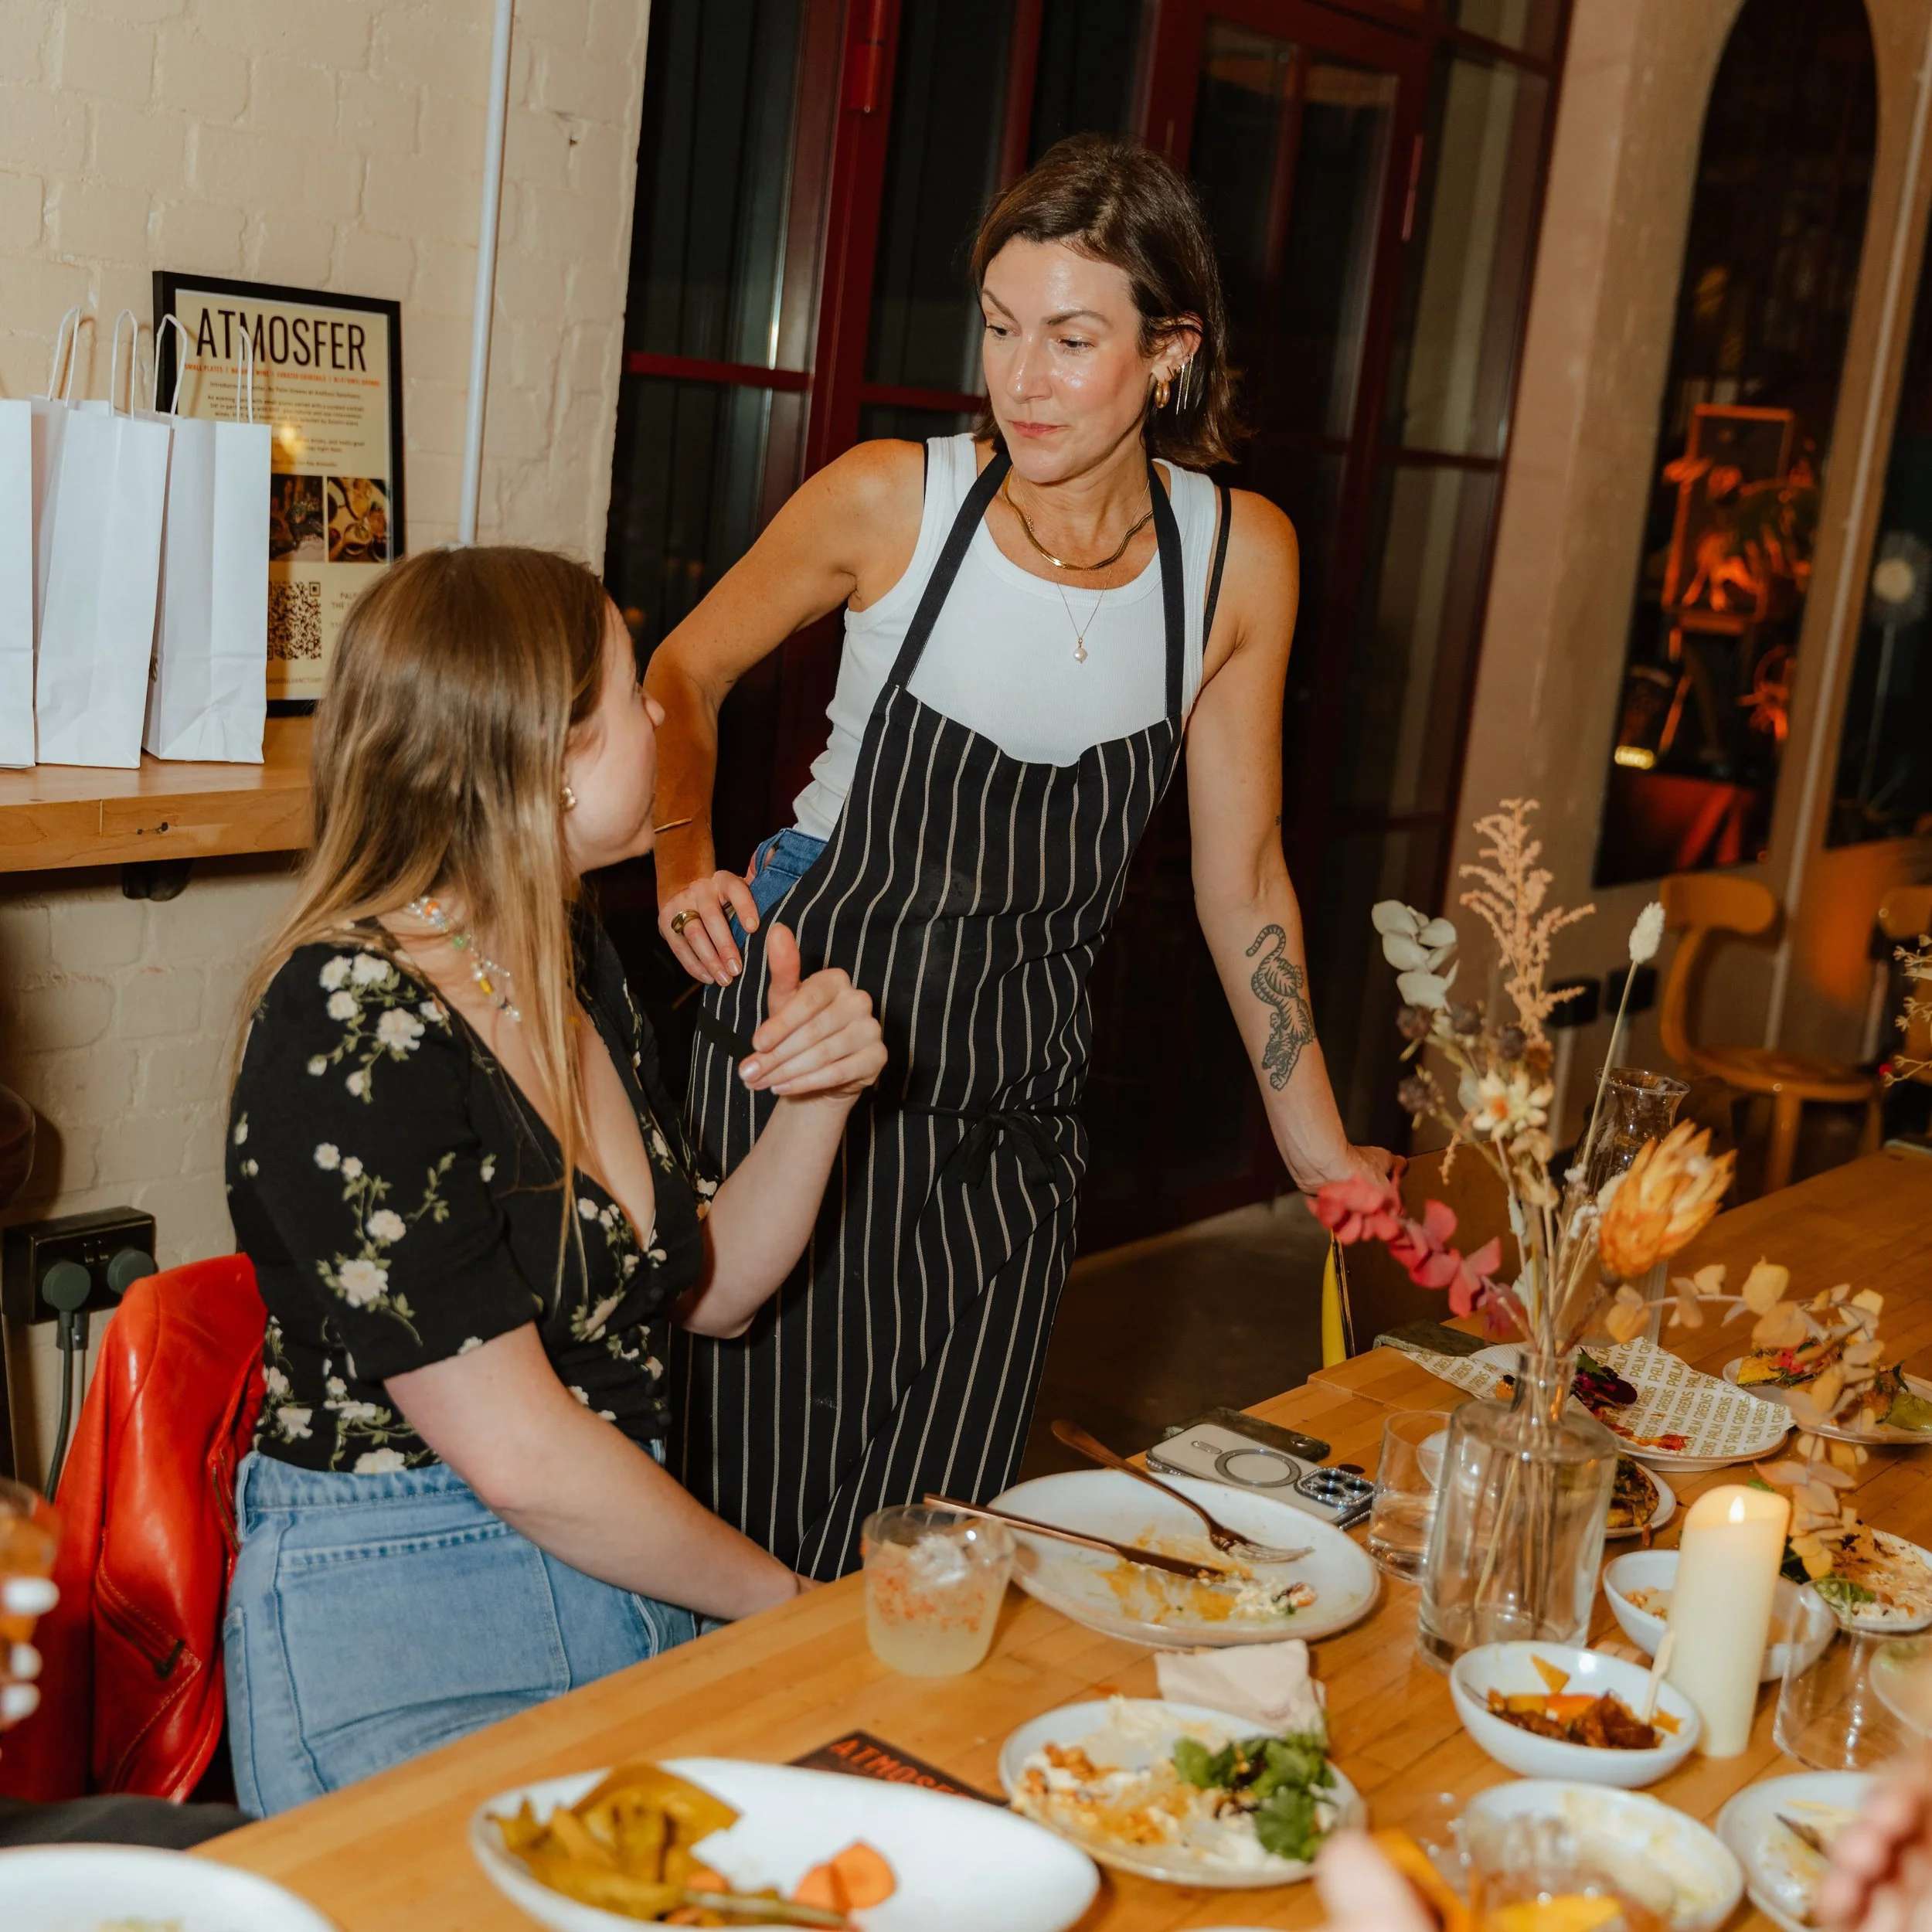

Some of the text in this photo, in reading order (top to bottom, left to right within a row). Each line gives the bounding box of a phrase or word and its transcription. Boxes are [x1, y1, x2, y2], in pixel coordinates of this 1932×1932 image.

[196, 308, 366, 372] ATMOSFER
[1629, 1355, 1648, 1379] PALM
[1665, 1360, 1685, 1387] PALM
[1637, 1385, 1658, 1408] GREENS
[1648, 1358, 1668, 1383] PALM
[1655, 1389, 1676, 1412] GREENS
[1674, 1391, 1696, 1416] GREENS
[1693, 1393, 1715, 1420] GREENS
[1713, 1396, 1733, 1423] GREENS
[1706, 1423, 1724, 1441] PALM
[1725, 1425, 1744, 1444] PALM
[1746, 1425, 1764, 1444] PALM
